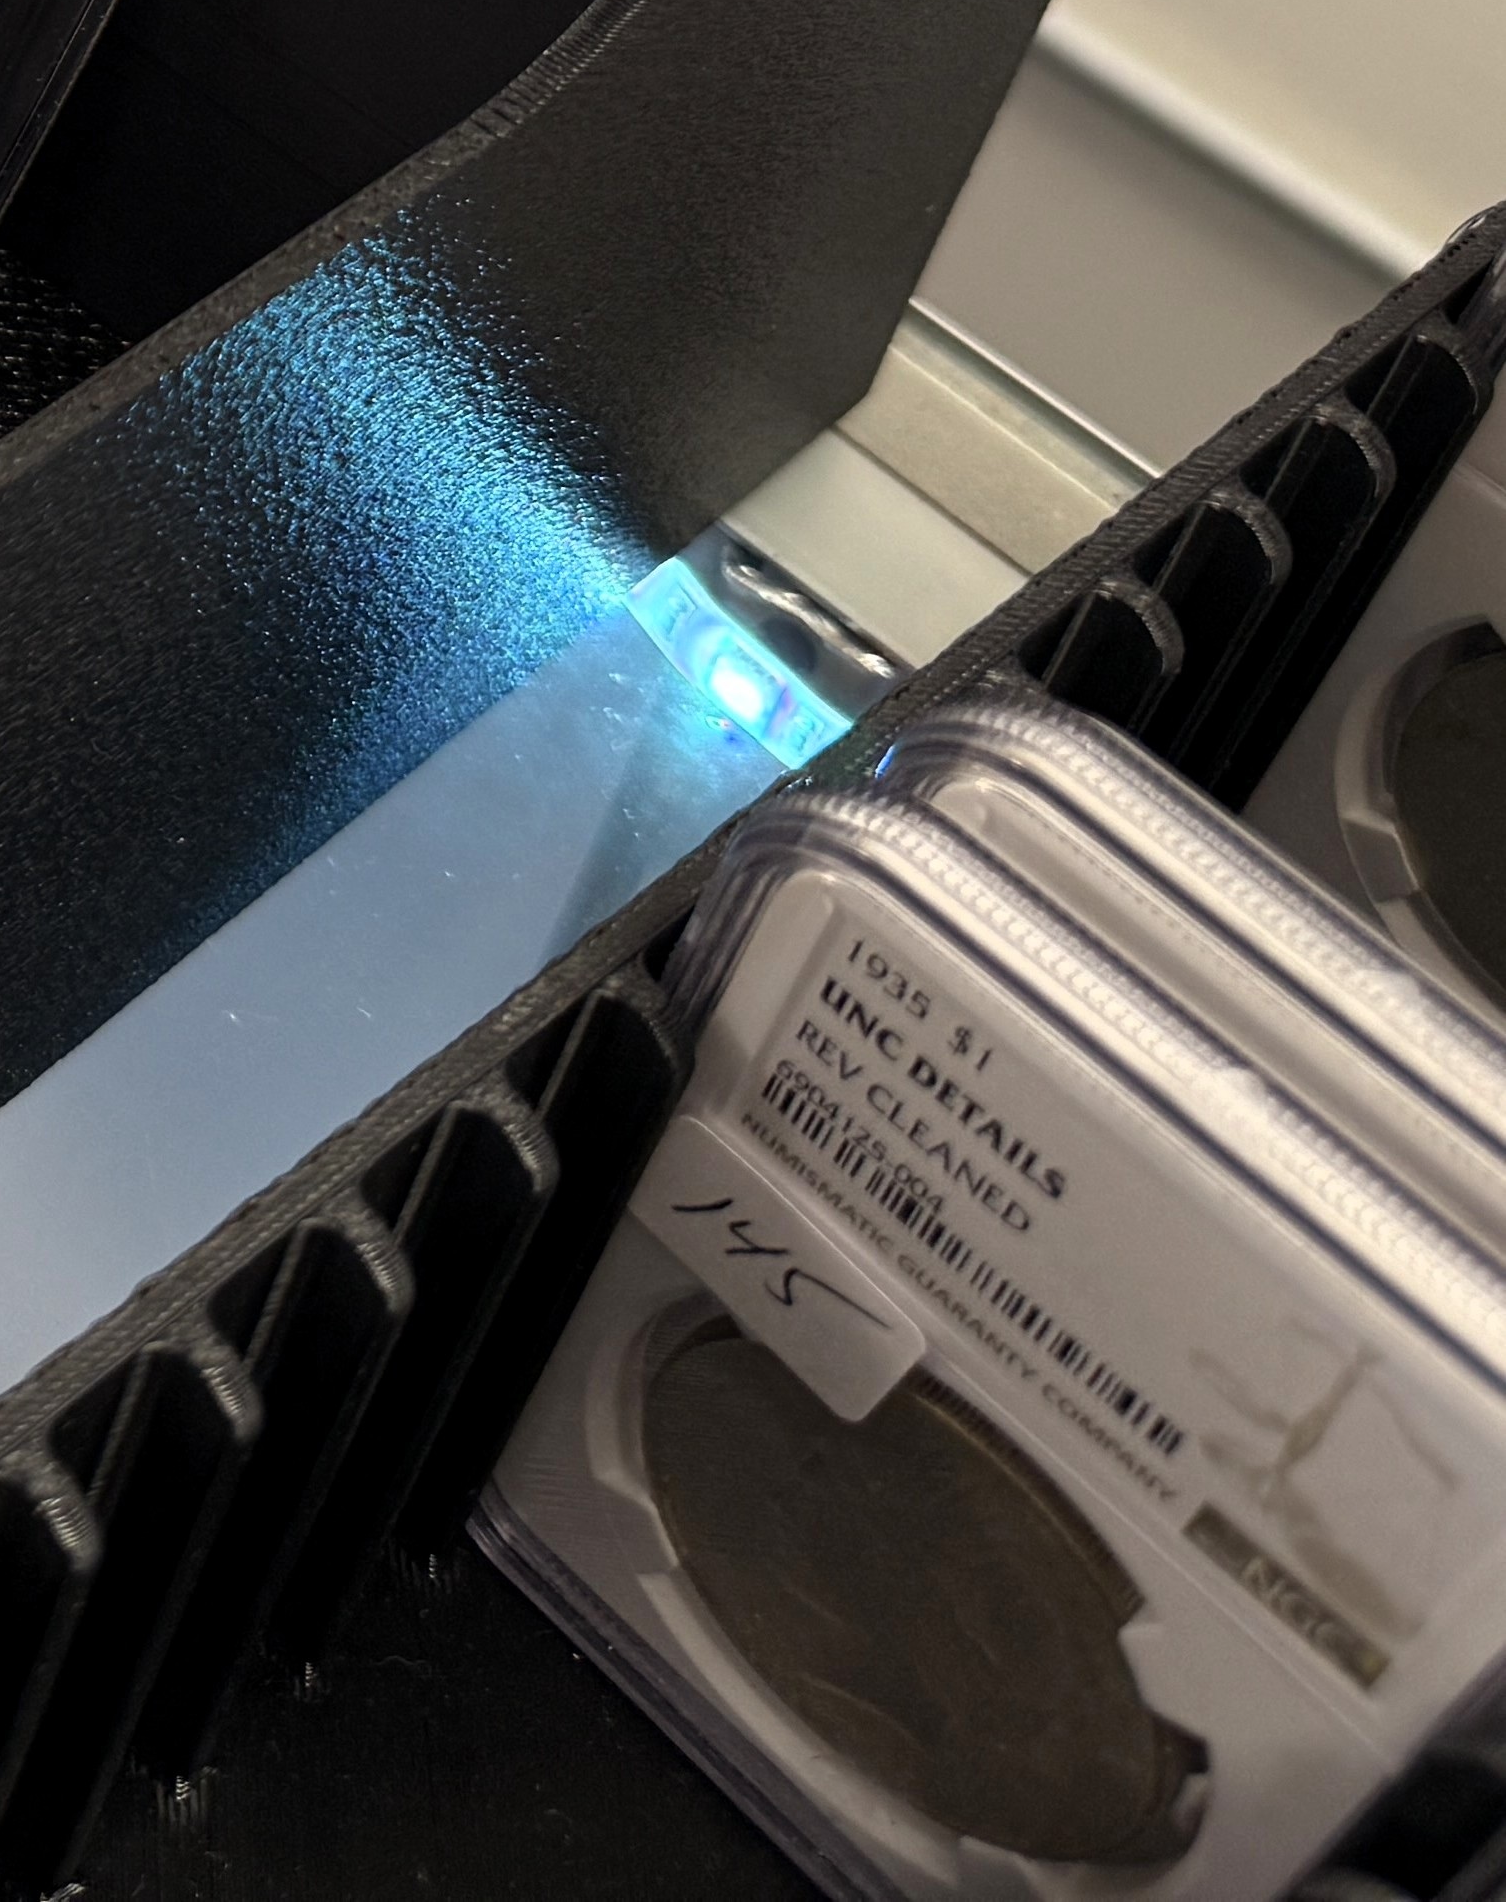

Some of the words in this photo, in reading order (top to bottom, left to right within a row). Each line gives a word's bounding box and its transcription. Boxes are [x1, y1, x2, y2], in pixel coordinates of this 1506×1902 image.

[820, 977, 903, 1063] UNC
[907, 1054, 1068, 1200] DETAILS
[846, 938, 932, 1020] 1935
[946, 1026, 992, 1074] $1
[796, 1019, 864, 1083] REV
[866, 1083, 1032, 1234] CLEANED
[739, 1112, 896, 1254] NUMISMATIC
[895, 1251, 1038, 1380] GUARANTY
[1040, 1381, 1179, 1503] COMPANY
